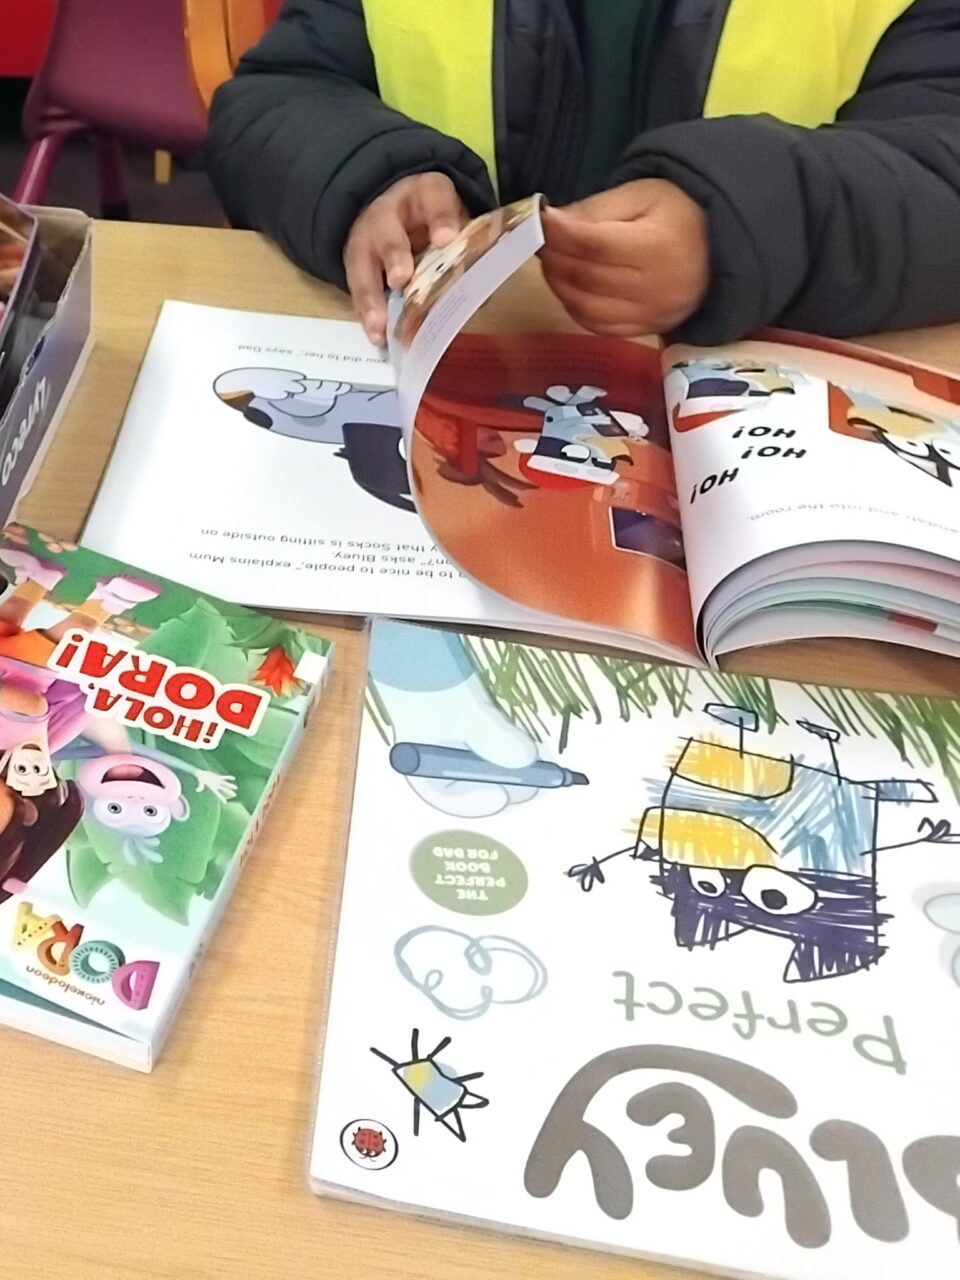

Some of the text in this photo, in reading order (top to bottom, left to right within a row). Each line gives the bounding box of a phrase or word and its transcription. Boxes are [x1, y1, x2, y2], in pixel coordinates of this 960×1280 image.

[731, 425, 796, 438] HO!
[741, 445, 807, 459] HO!
[690, 467, 739, 505] HO!
[222, 531, 276, 542] outside
[280, 535, 326, 547] sitting
[347, 540, 391, 551] Socks
[396, 544, 425, 553] that
[229, 555, 292, 569] explains
[380, 555, 416, 564] asks
[379, 567, 411, 577] nice
[415, 570, 434, 579] be
[55, 633, 263, 730] DORA!
[432, 846, 499, 861] FOR DAD
[443, 860, 491, 874] BOOK
[434, 873, 507, 888] PERFECT
[455, 888, 489, 901] THE
[11, 900, 161, 1011] DORA
[25, 964, 106, 1006] nickelodeon
[612, 970, 907, 1076] Perfect
